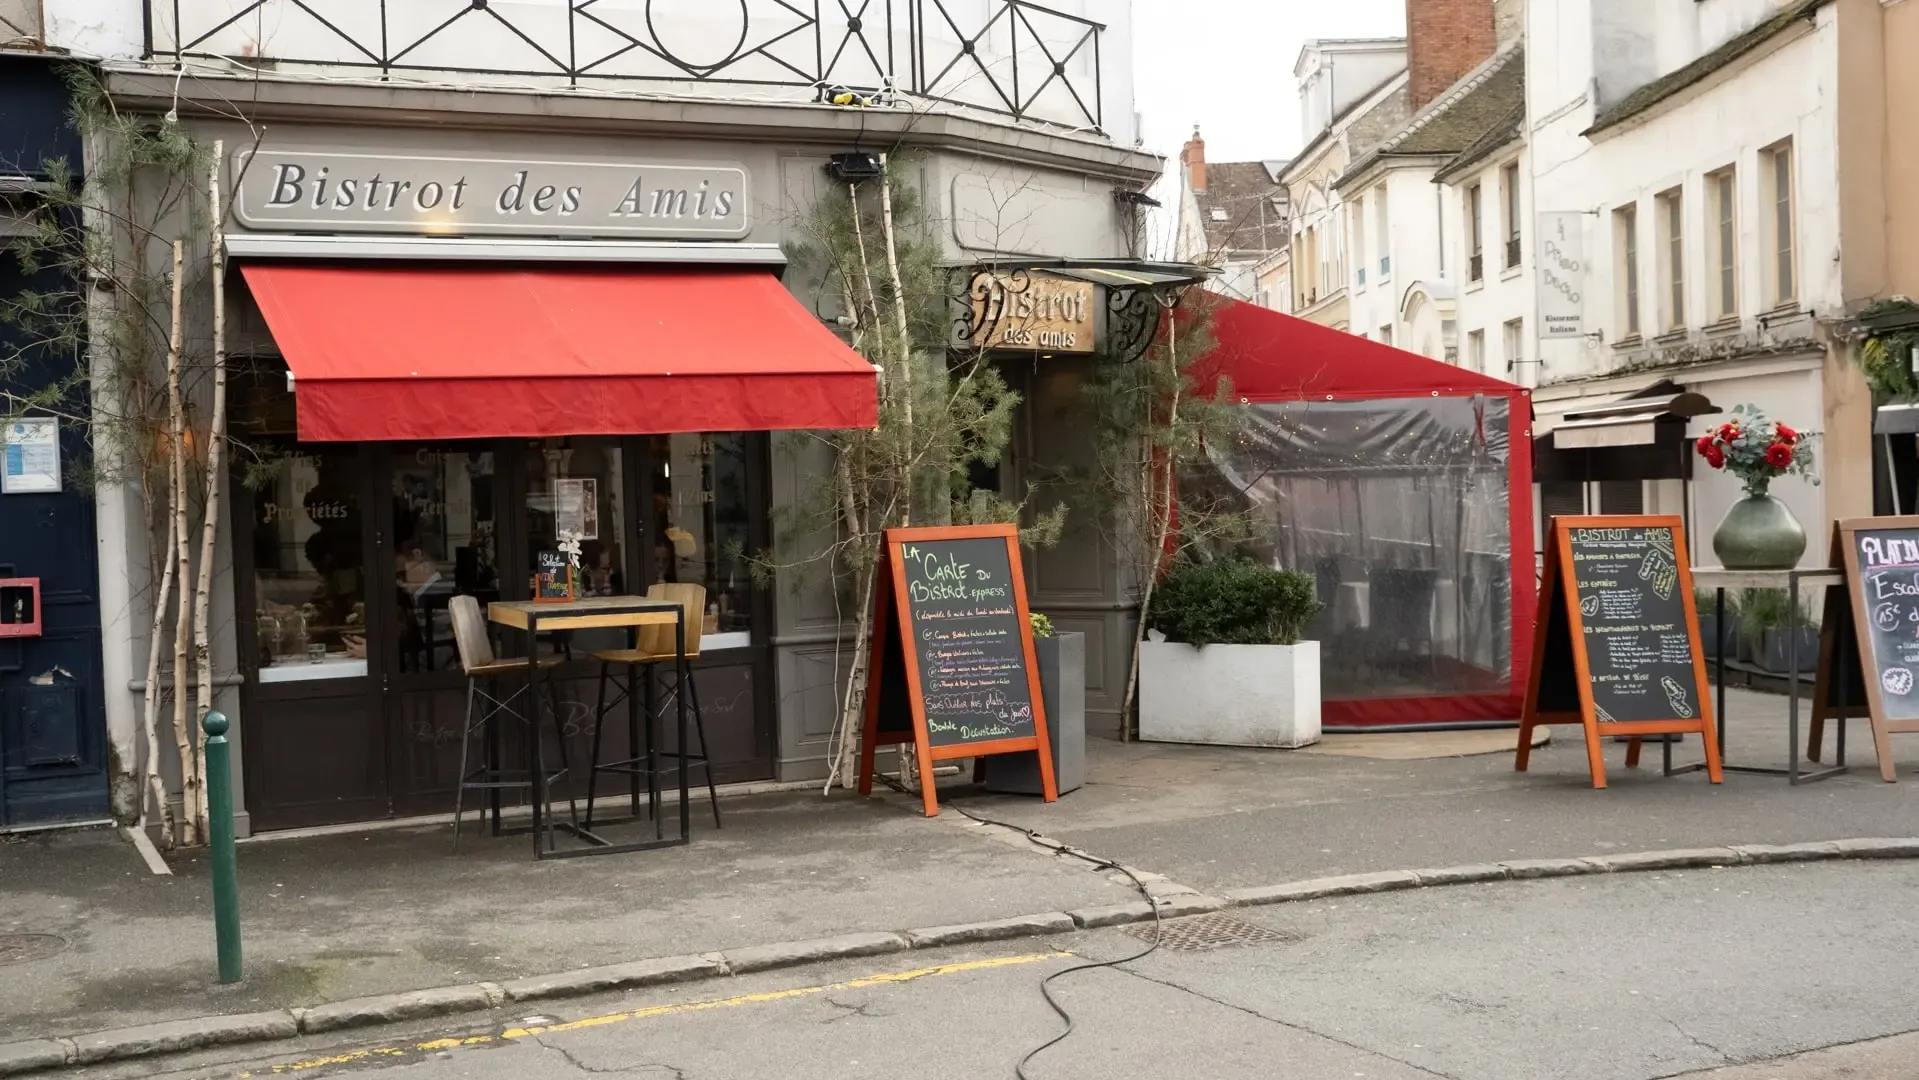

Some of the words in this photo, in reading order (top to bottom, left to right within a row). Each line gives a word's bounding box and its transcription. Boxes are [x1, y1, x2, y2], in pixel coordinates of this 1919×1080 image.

[265, 162, 467, 213] Bistrot
[496, 170, 583, 217] des
[609, 175, 734, 219] Amis
[1004, 323, 1034, 346] des
[1039, 328, 1078, 349] amis
[1578, 528, 1632, 542] BISTROT
[1644, 527, 1672, 541] AMIS
[902, 543, 921, 563] LA
[1861, 536, 1902, 565] PLAT
